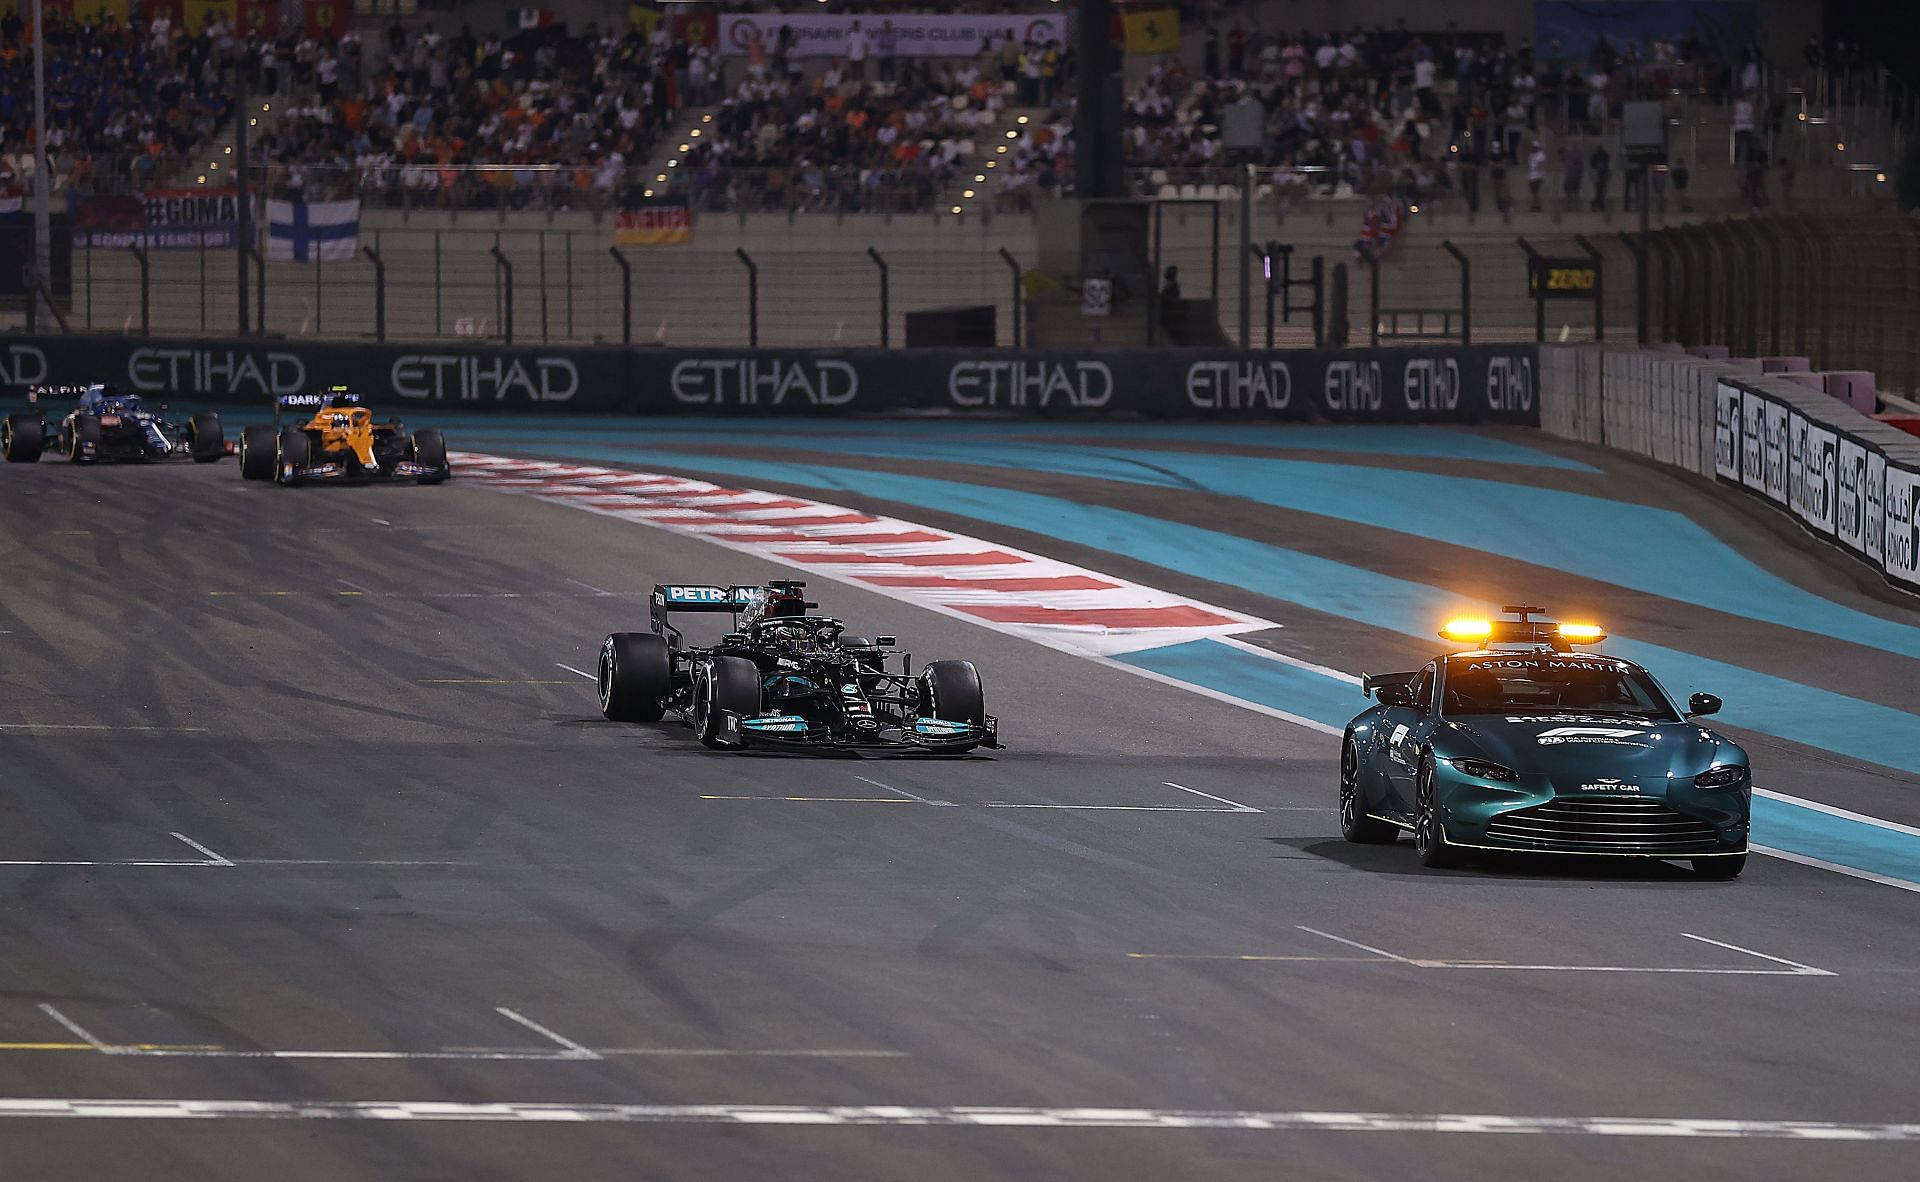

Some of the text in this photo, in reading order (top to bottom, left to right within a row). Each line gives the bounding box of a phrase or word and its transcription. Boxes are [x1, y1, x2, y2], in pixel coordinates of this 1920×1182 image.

[1547, 269, 1595, 289] ZERO
[128, 349, 306, 394] ETIHAD
[391, 355, 579, 401] ETIHAD
[671, 359, 859, 404] ETIHAD
[949, 361, 1113, 408] ETIHAD
[1187, 361, 1291, 409] ETIHAD
[1325, 360, 1382, 410] ETIHAD
[1404, 358, 1460, 411] ETIHAD
[1487, 356, 1533, 412] ETIHAD
[1887, 532, 1910, 570] ADNOC
[1468, 660, 1630, 675] ASTON MARTIN
[1619, 784, 1641, 792] CAR
